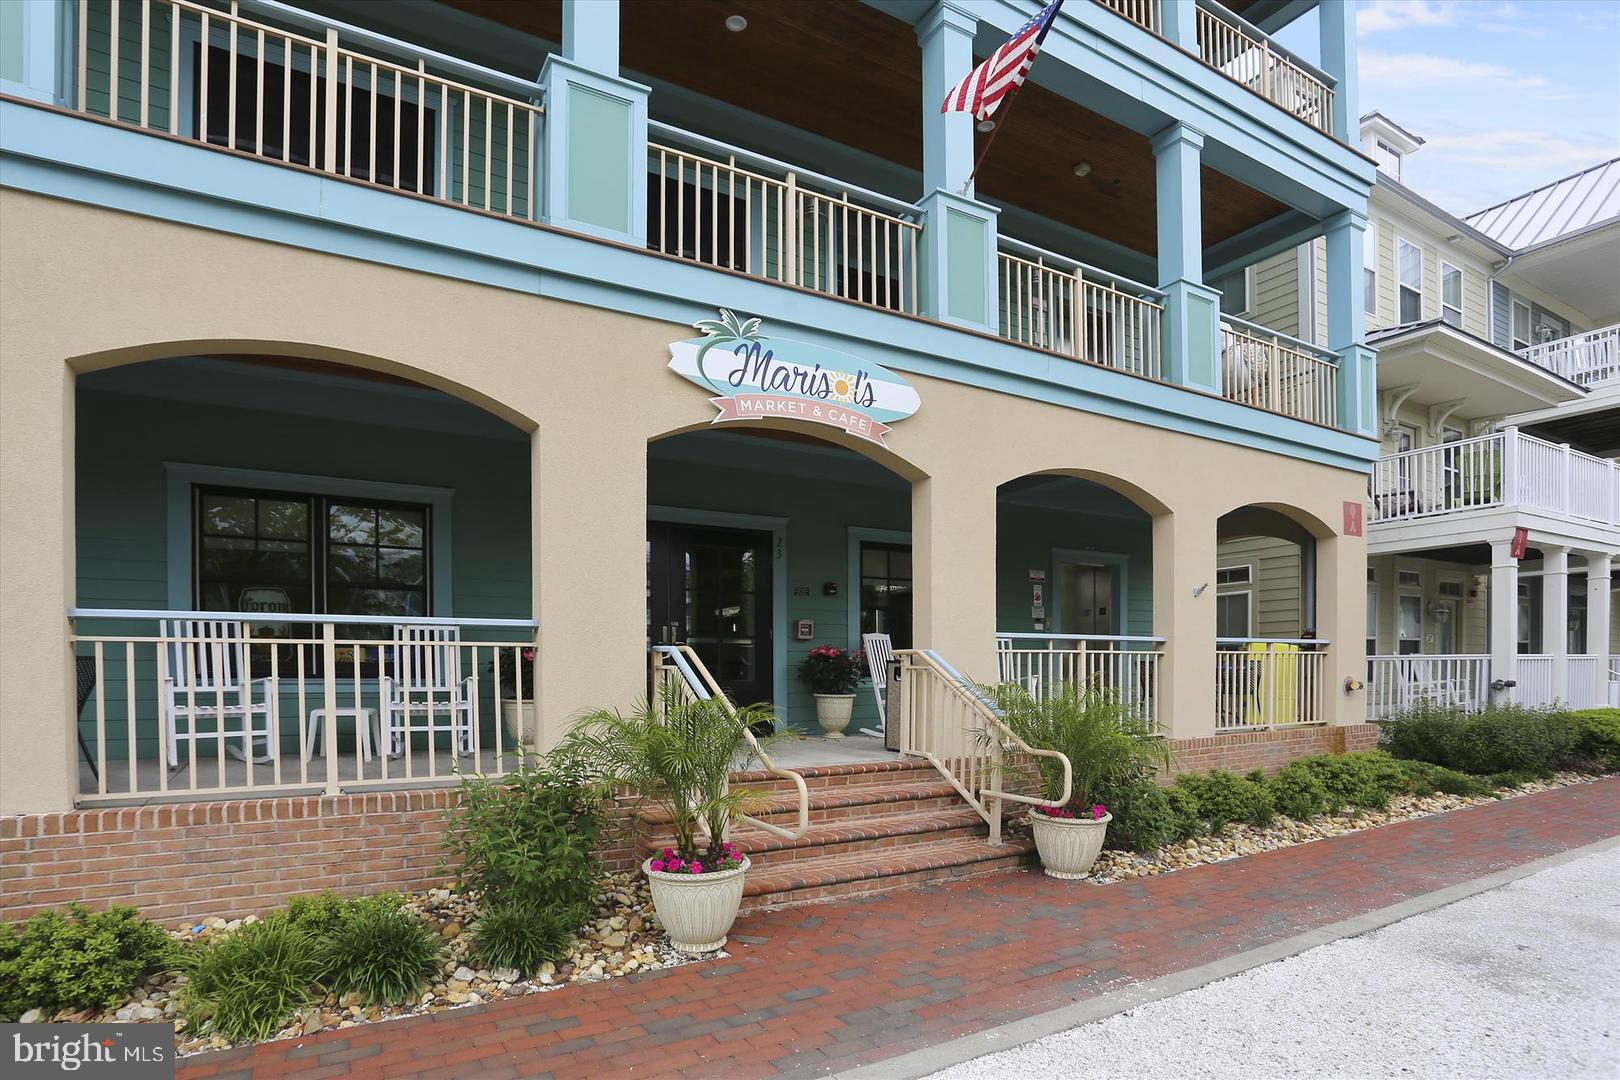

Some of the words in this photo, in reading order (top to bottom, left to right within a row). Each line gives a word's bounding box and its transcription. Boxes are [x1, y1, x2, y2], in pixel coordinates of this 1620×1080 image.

[728, 341, 877, 408] Marisol's
[740, 399, 806, 414] MARKET
[812, 405, 823, 416] &
[828, 409, 867, 430] CAFE
